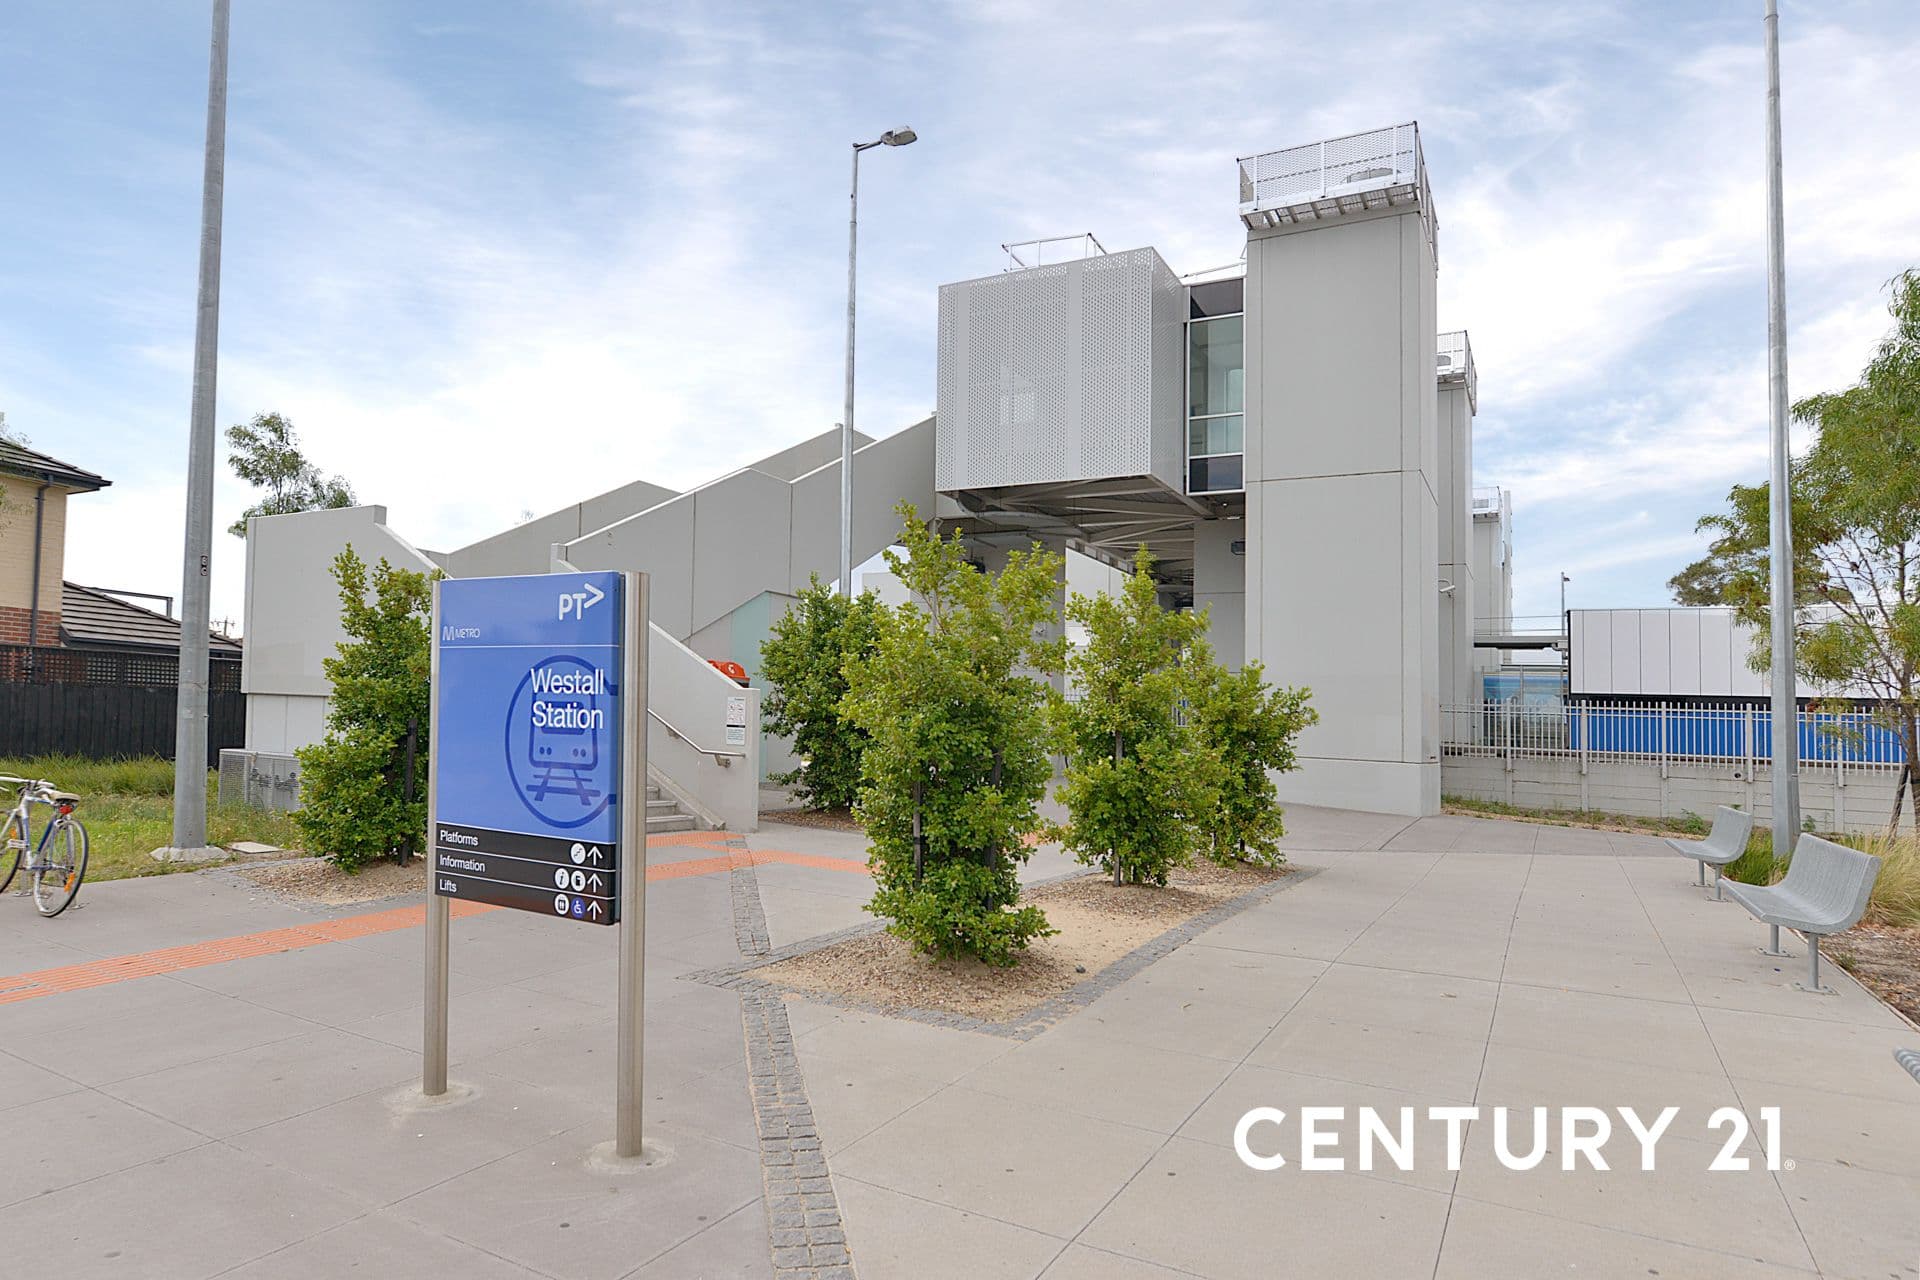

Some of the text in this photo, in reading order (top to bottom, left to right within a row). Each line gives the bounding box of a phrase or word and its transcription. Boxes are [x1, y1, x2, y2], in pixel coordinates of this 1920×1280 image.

[530, 668, 604, 695] Westall
[532, 701, 604, 729] Station
[440, 829, 479, 846] Platforms
[440, 854, 486, 873] Information
[440, 878, 457, 893] Lifts
